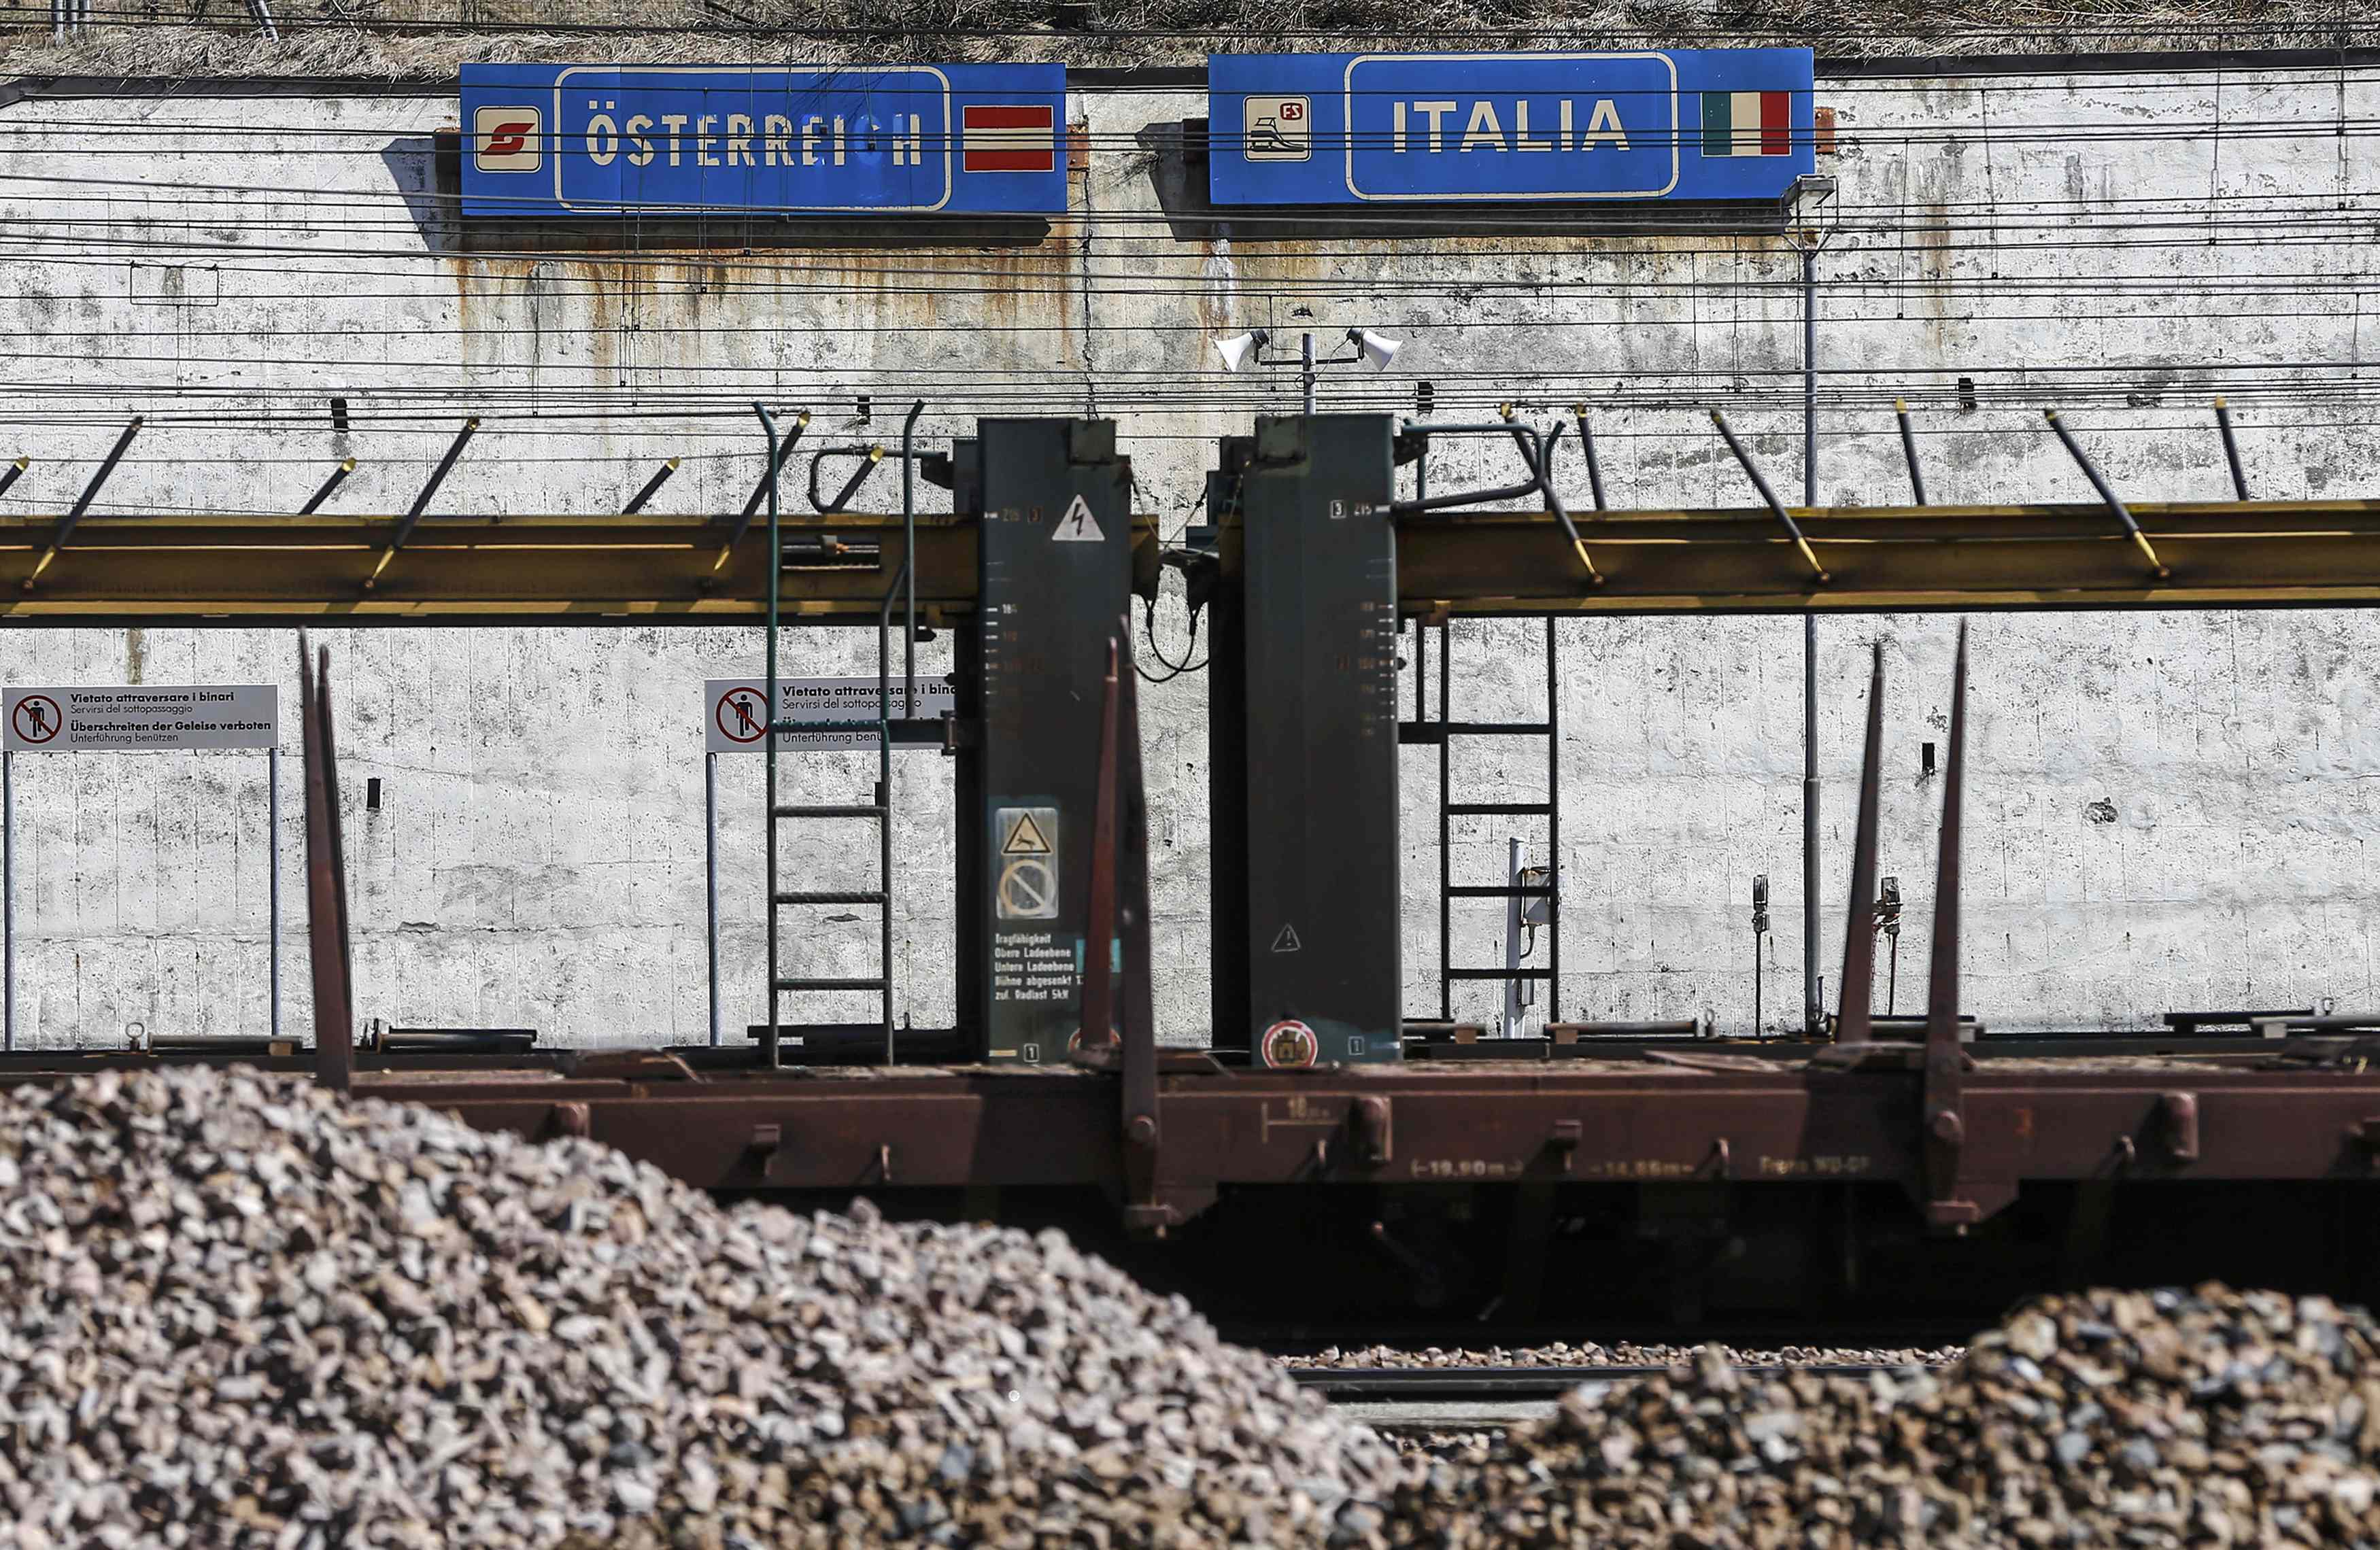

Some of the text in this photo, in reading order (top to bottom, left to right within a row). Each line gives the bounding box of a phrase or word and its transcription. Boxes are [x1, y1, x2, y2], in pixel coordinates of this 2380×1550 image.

[1283, 105, 1300, 118] FS
[1394, 100, 1630, 153] ITALIA
[783, 686, 830, 696] Vietato
[71, 694, 112, 703] Vietato
[116, 693, 189, 702] attraversare
[199, 692, 234, 702] binari
[71, 704, 192, 714] Servirsi del sottopassaggio
[783, 699, 820, 709] Servirsi
[823, 698, 839, 708] del
[71, 720, 271, 731] Überschreiten der Geleise verboten
[71, 733, 178, 744] Unterführung benützen
[783, 732, 851, 744] Unterführung
[995, 948, 1071, 958] Obere Ladeebene
[995, 962, 1074, 972] Untere Ladeebene
